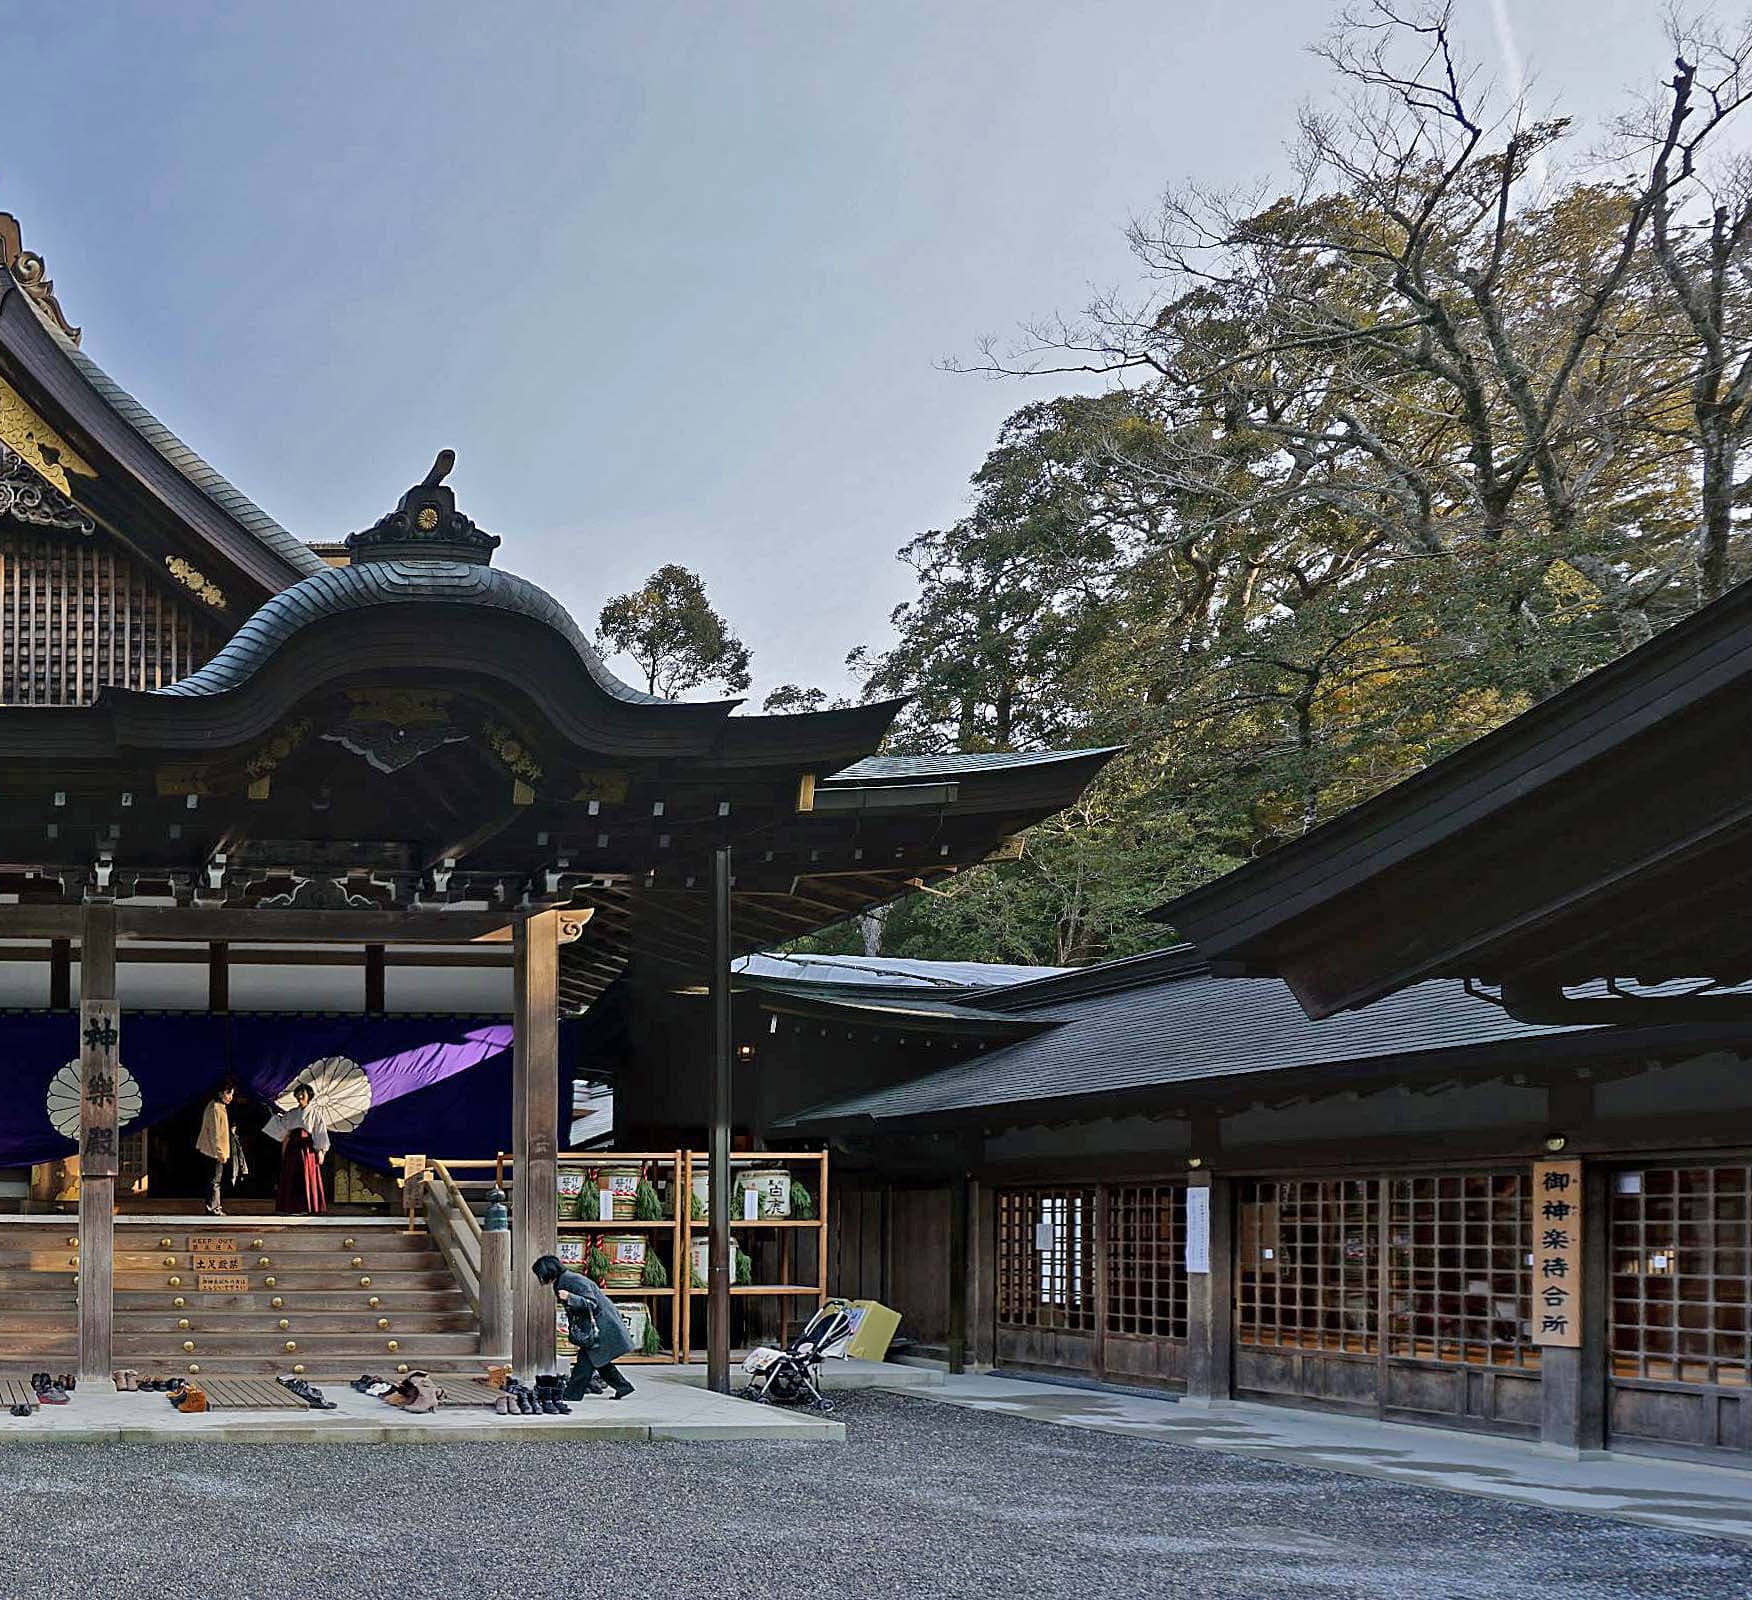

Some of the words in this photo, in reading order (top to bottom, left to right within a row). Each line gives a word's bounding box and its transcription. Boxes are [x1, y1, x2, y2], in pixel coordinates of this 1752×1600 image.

[196, 1260, 239, 1270] 土足厳禁
[1541, 1171, 1570, 1336] 御神楽待合所
